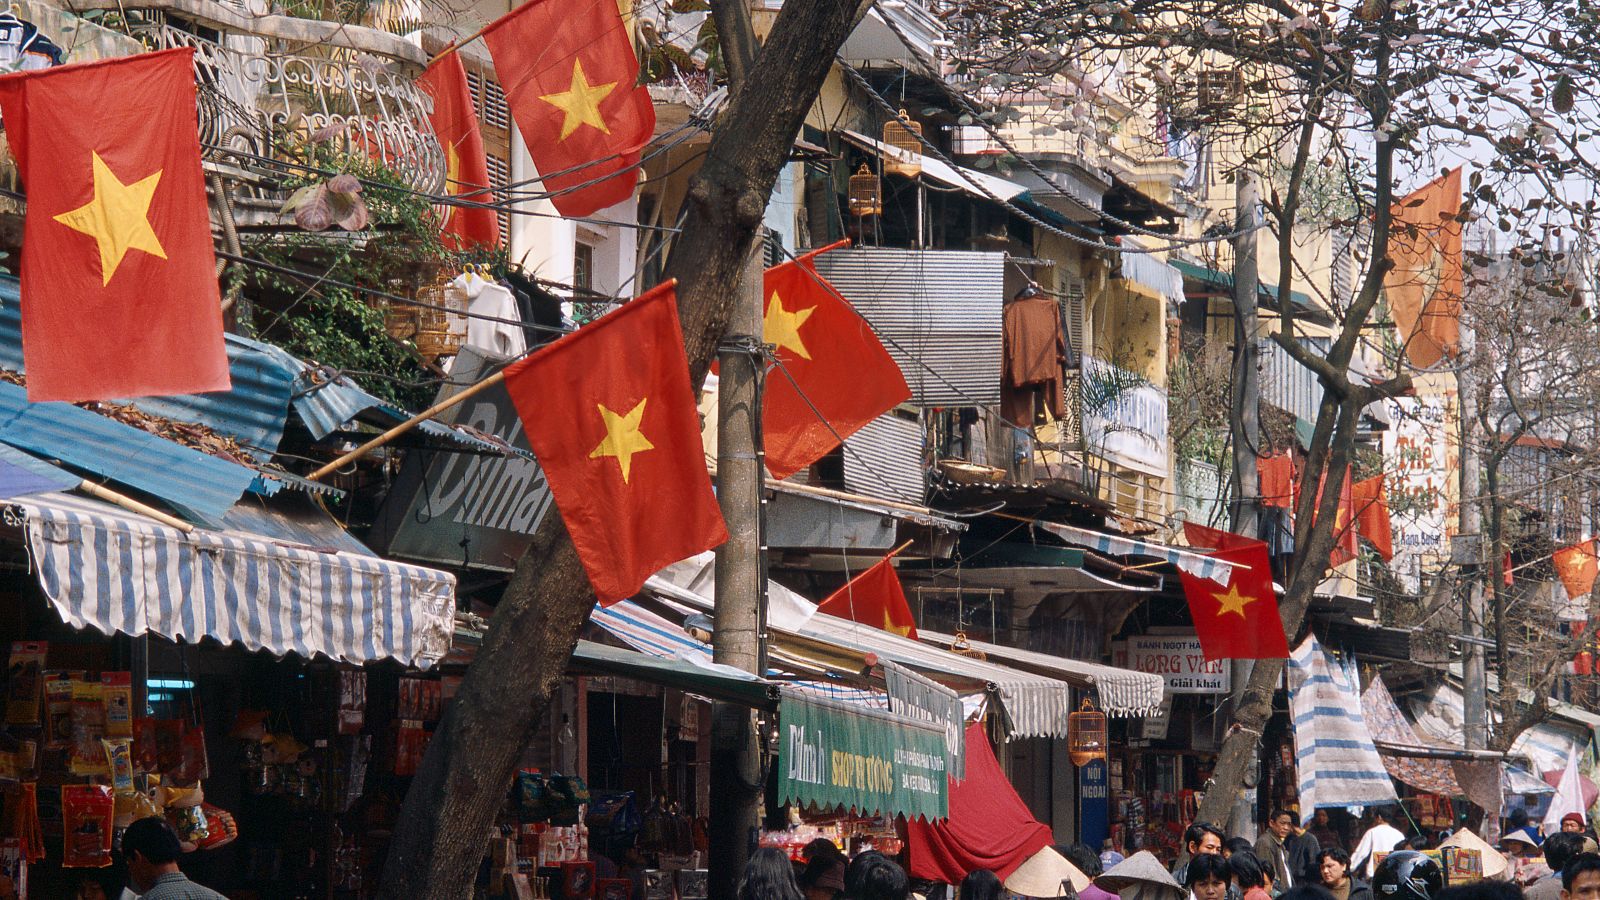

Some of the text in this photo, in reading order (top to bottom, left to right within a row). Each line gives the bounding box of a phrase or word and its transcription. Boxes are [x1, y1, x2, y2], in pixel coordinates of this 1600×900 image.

[1135, 654, 1181, 674] LONG
[1196, 678, 1221, 688] khát
[788, 725, 826, 785] Dilmah
[832, 750, 855, 787] SHOP
